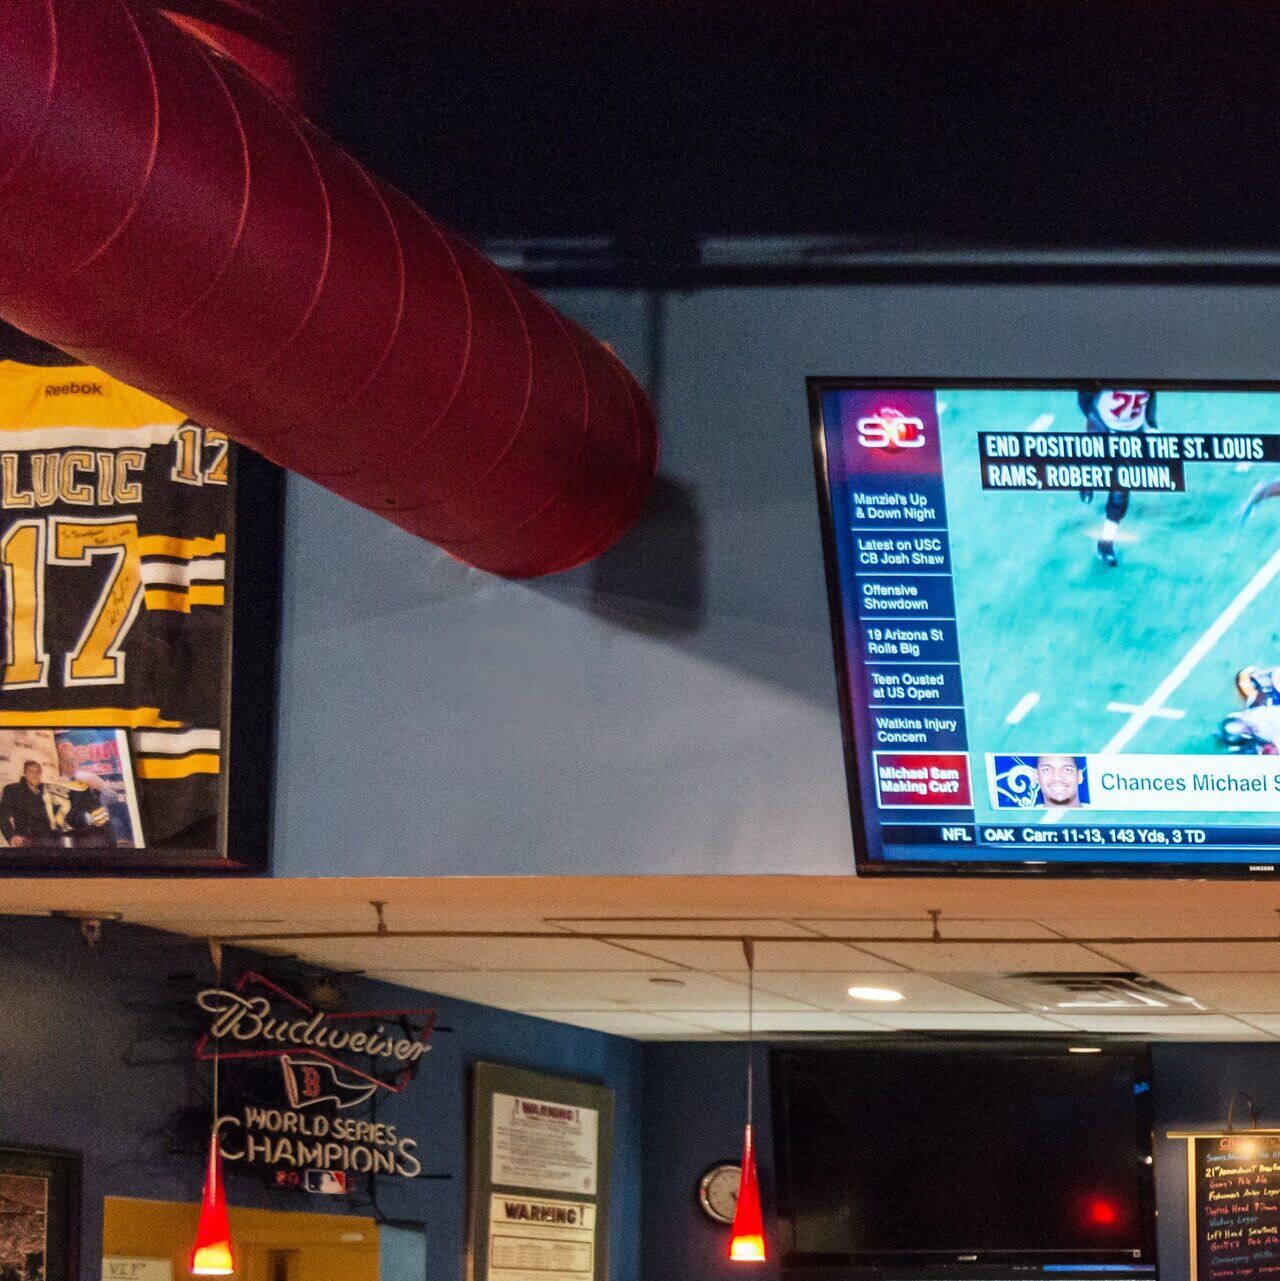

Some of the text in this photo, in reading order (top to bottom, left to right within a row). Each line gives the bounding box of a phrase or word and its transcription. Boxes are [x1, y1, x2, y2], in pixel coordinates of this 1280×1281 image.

[45, 382, 103, 396] Reebok
[857, 417, 925, 448] SC
[986, 435, 1263, 460] END POSITION FOR THE ST. LOUIS
[2, 452, 146, 509] LUCIC
[988, 465, 1176, 491] RAMS, ROBERT QUINN,
[853, 492, 928, 508] Manziel's Up
[856, 508, 936, 522] & Down Night
[858, 539, 942, 551] Latest on USC
[860, 553, 944, 564] CB Josh Shaw
[863, 584, 918, 596] Offensive
[0, 515, 144, 690] 17
[865, 597, 929, 610] Showdown
[867, 629, 944, 641] 19 Arizona St
[868, 643, 920, 656] Rolls Big
[872, 673, 944, 686] Teen Ousted
[873, 687, 940, 701] at US Open
[877, 718, 957, 732] Watkins Injury
[877, 732, 927, 743] Concern
[878, 767, 960, 780] Michael Sam
[880, 781, 960, 795] Making Cut?
[1101, 773, 1186, 792] Chances
[1193, 773, 1267, 792] Michael
[942, 828, 1206, 845] NFL OAK Carr: 11-13, 143 Yds, 3 TD
[197, 989, 432, 1061] Budweiser
[245, 1106, 398, 1146] WORLD SERIES
[214, 1115, 422, 1178] CHAMPIONS
